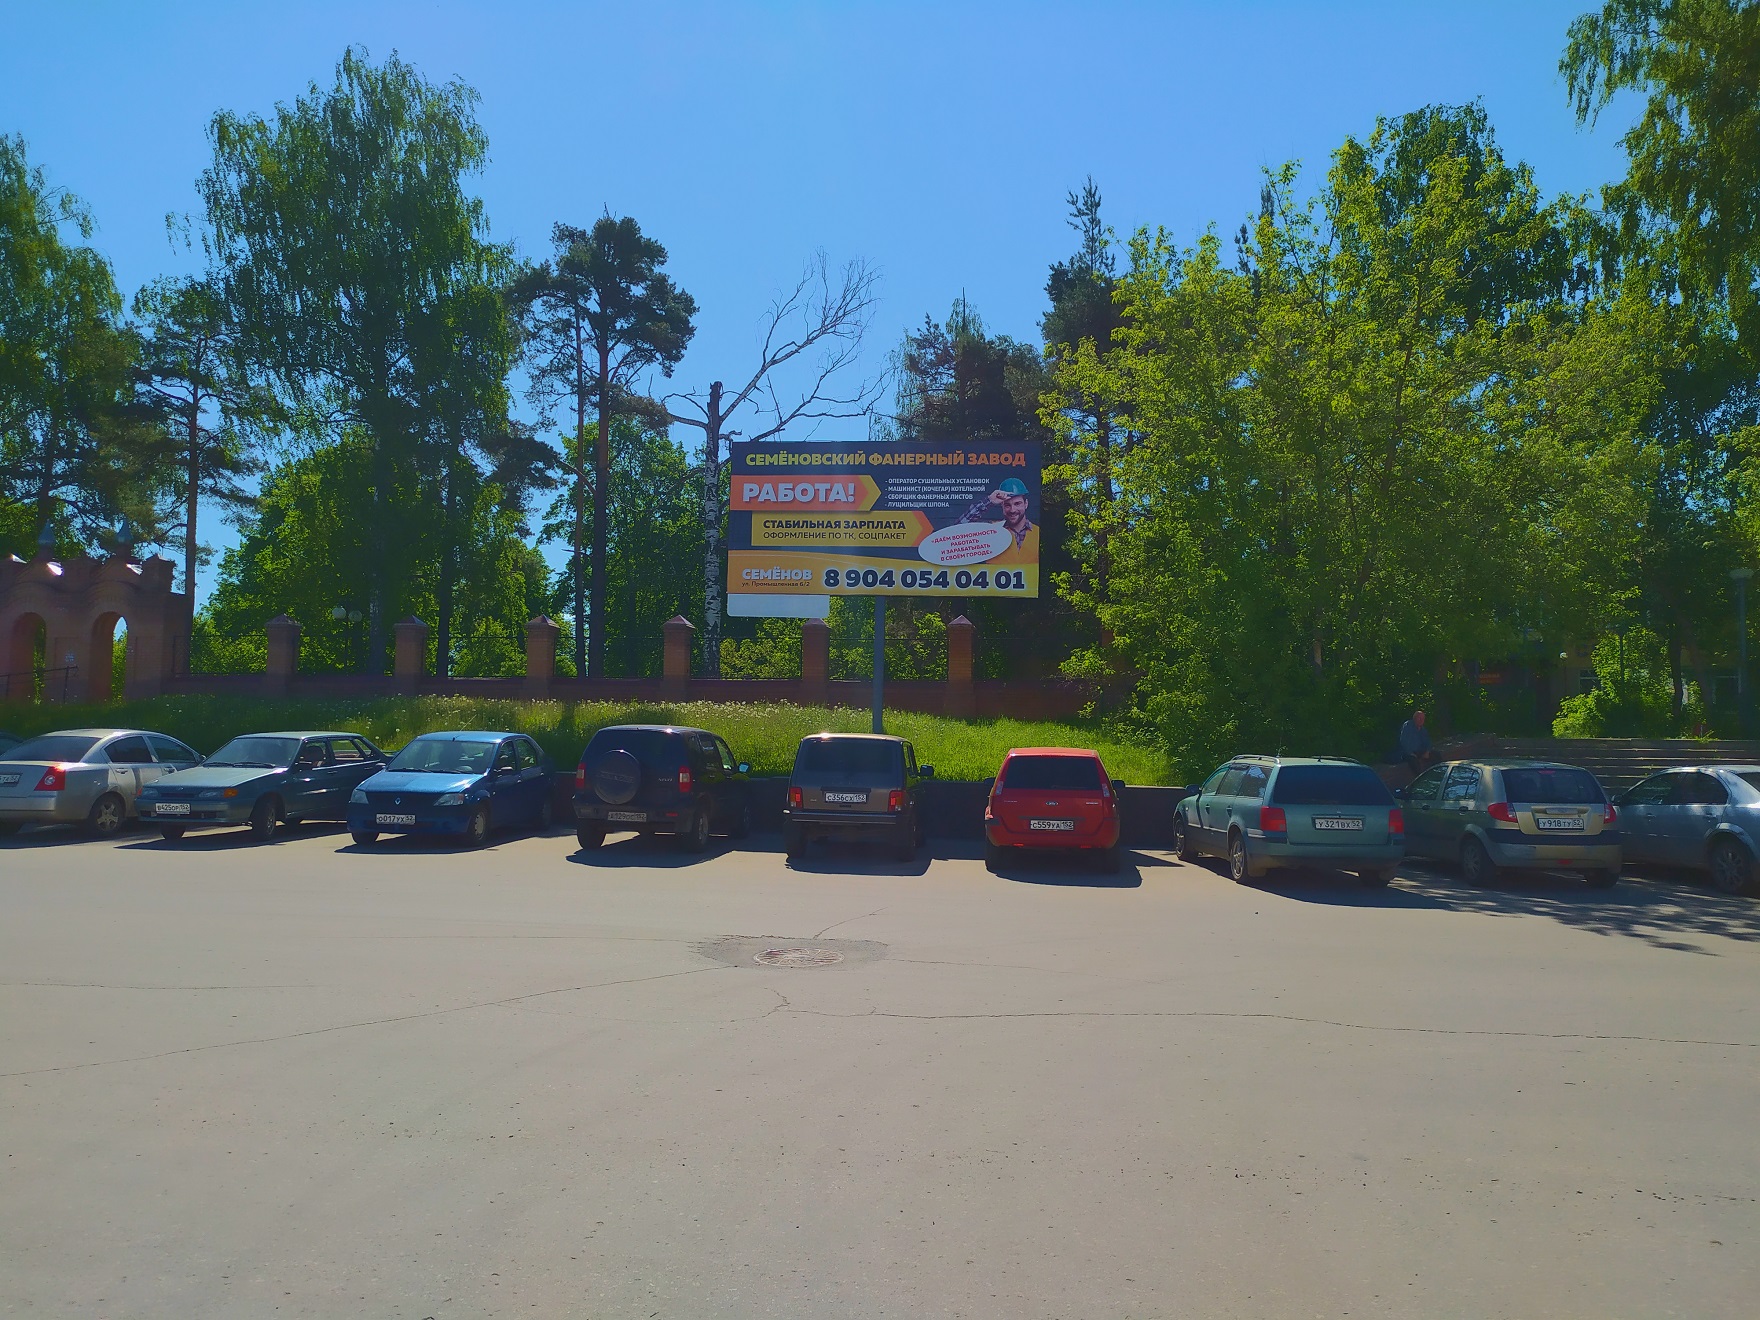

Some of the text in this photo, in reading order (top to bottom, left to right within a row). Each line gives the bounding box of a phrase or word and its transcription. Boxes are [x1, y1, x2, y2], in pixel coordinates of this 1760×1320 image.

[746, 450, 1026, 467] СЕМЁНОВСКИЙ ФАНЕРНЫЙ ЗАВОД
[742, 482, 855, 503] РАБОТА!
[763, 520, 906, 529] СТАБИЛЬНАЯ ЗАРПЛАТА
[843, 532, 857, 541] ТК,
[858, 532, 906, 541] СОЦПАКЕТ
[951, 530, 998, 542] ВОЗМОЖНОСТЬ
[950, 539, 980, 547] РАБОТАТЬ
[946, 544, 991, 555] ЗАРАБАТЫВАТЬ
[742, 566, 1026, 590] СЕМЁНОВ 8 904 054 04 01
